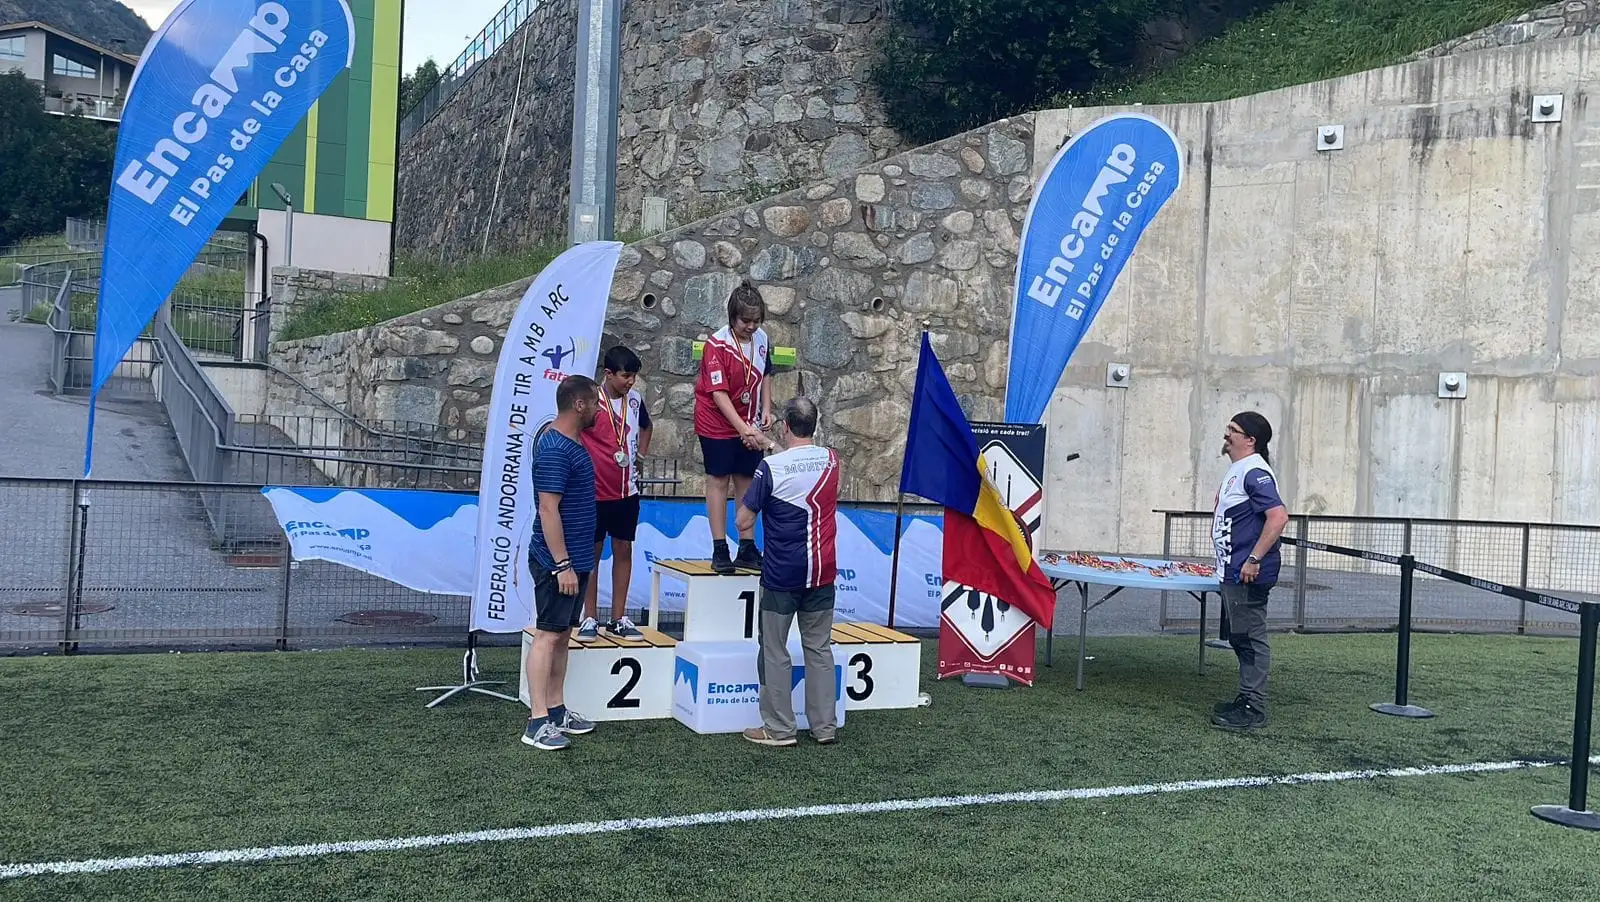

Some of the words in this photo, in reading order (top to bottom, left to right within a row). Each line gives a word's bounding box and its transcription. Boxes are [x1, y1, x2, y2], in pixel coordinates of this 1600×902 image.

[116, 1, 290, 205] Encamp
[169, 196, 200, 227] El
[189, 153, 234, 199] Pas
[230, 118, 261, 151] de
[251, 90, 283, 117] la
[274, 29, 329, 88] Casa
[1027, 143, 1136, 308] Encamp
[1065, 298, 1086, 321] El
[1077, 262, 1104, 298] Pas
[1101, 233, 1119, 260] de
[1112, 211, 1132, 231] la
[1126, 161, 1165, 209] Casa
[541, 284, 569, 320] ARC
[513, 373, 532, 396] TIR
[509, 403, 528, 425] DE
[497, 433, 524, 530] ANDORRANA
[487, 536, 511, 621] FEDERACIÓ
[839, 583, 858, 592] Casa
[738, 590, 755, 638] 1
[607, 657, 642, 709] 2
[708, 682, 759, 694] Encam
[716, 697, 729, 705] Pas
[742, 696, 749, 704] la
[846, 652, 874, 701] 3
